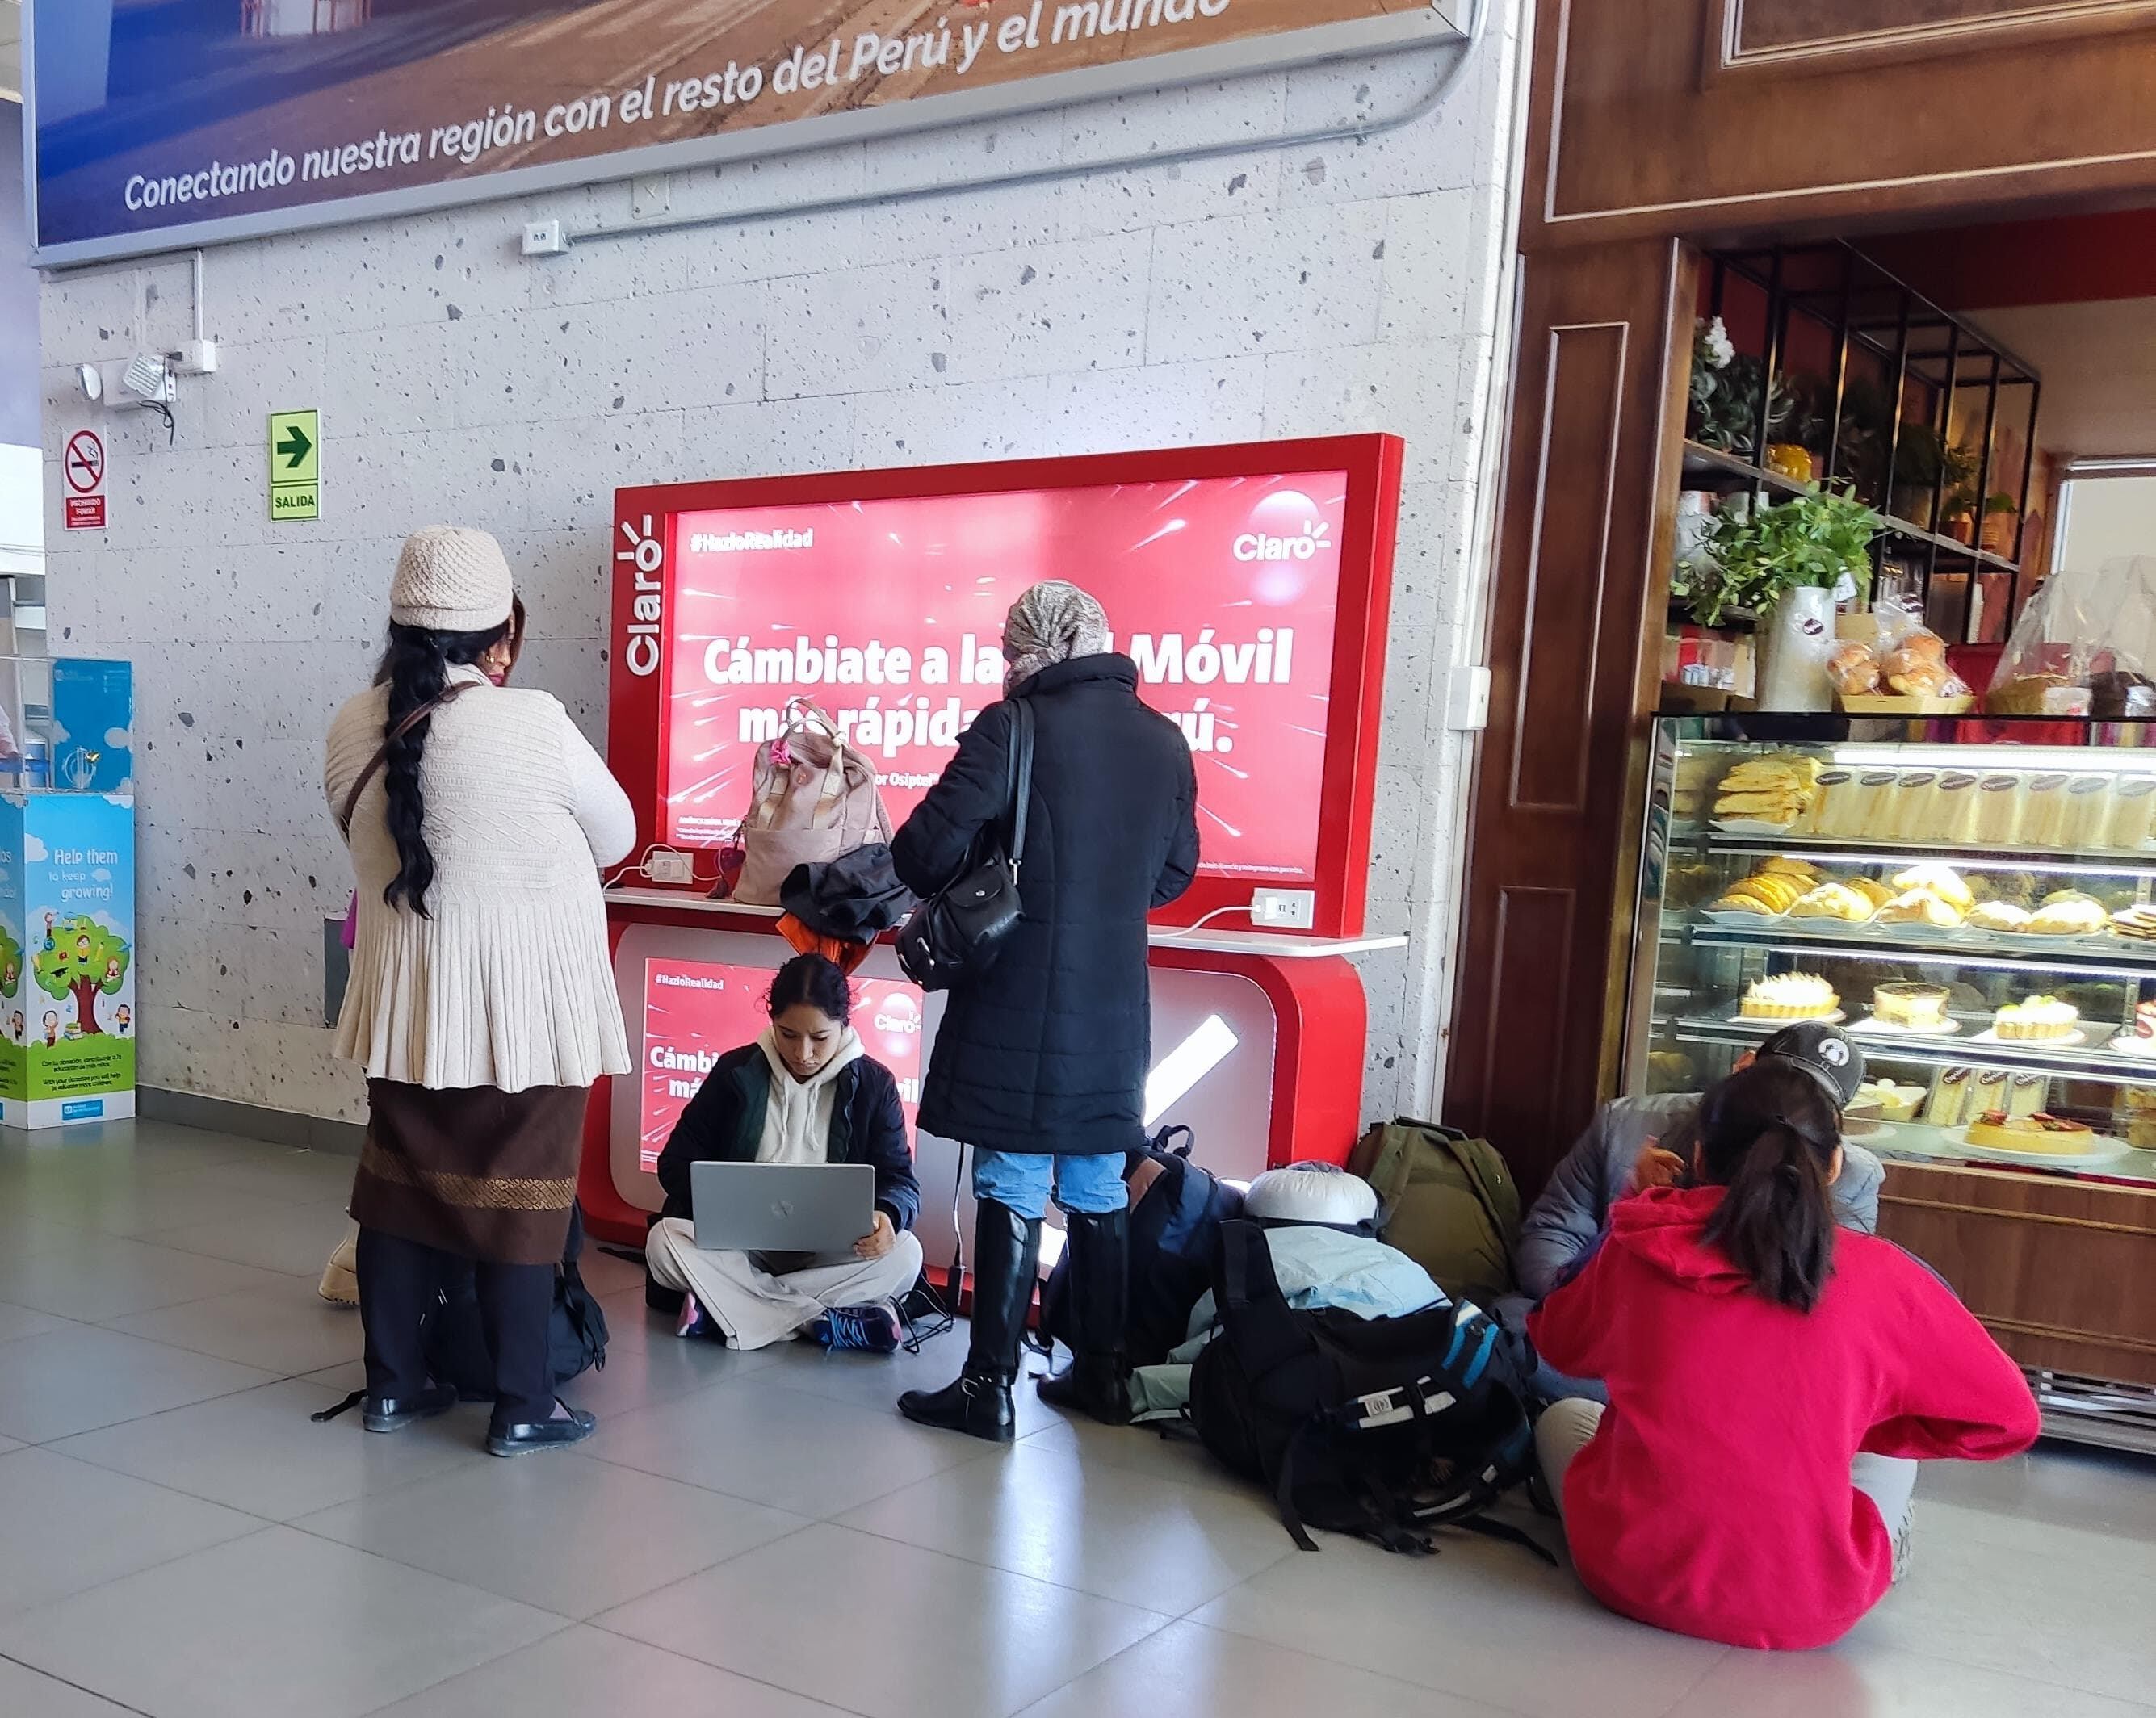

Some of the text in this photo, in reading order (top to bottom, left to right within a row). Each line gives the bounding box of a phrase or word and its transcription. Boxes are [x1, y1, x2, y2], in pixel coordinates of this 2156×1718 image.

[124, 148, 296, 211] Conectando
[302, 128, 422, 182] nuestra
[428, 103, 536, 165] región
[544, 95, 611, 138] con
[619, 76, 656, 124] el
[662, 61, 764, 117] resto
[772, 39, 841, 95] del
[849, 15, 952, 81] Perú
[956, 20, 990, 75] y
[997, 0, 1043, 53] el
[275, 494, 315, 509] SALIDA
[1232, 524, 1326, 562] Claro
[620, 525, 663, 676] Claro
[703, 634, 912, 685] Cámbiate
[920, 646, 949, 685] a
[960, 633, 1005, 685] la
[1128, 626, 1294, 685] Móvil
[875, 773, 888, 786] or
[54, 848, 118, 865] Help them
[48, 869, 86, 882] to keep
[61, 883, 113, 902] growing!
[655, 974, 724, 990] #HazloRealidad
[650, 1045, 719, 1074] Cámbi
[669, 1077, 703, 1099] má
